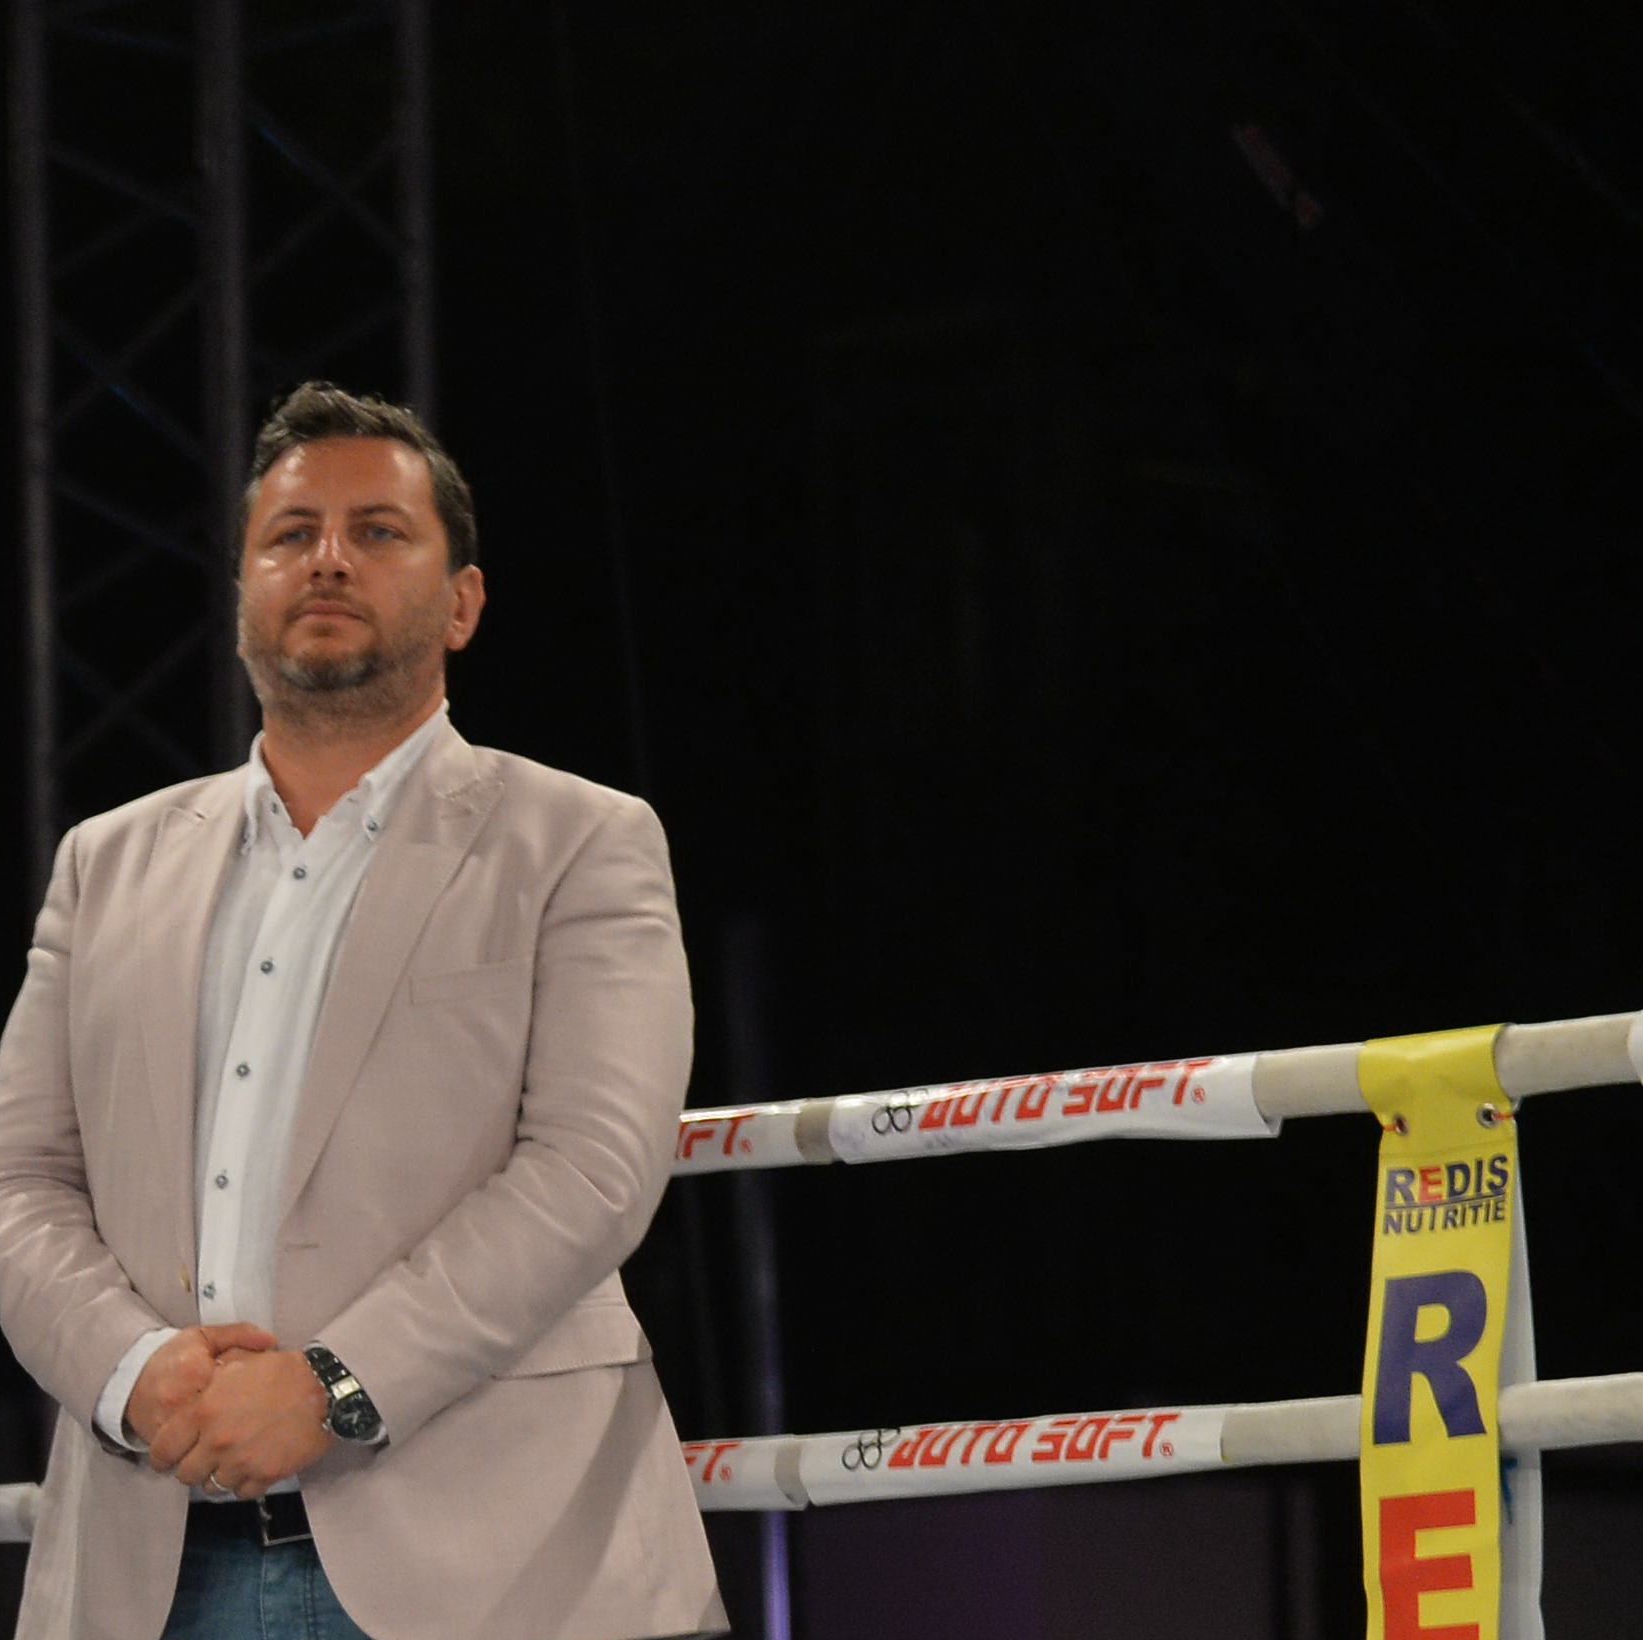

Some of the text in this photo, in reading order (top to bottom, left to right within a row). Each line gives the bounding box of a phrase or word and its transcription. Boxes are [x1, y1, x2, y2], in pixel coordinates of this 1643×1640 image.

[918, 1058, 1215, 1130] AUTO SOFT
[1386, 1154, 1509, 1207] REDIS
[1383, 1200, 1505, 1234] NUTRITIE
[887, 1412, 1182, 1468] AUTO SOFT
